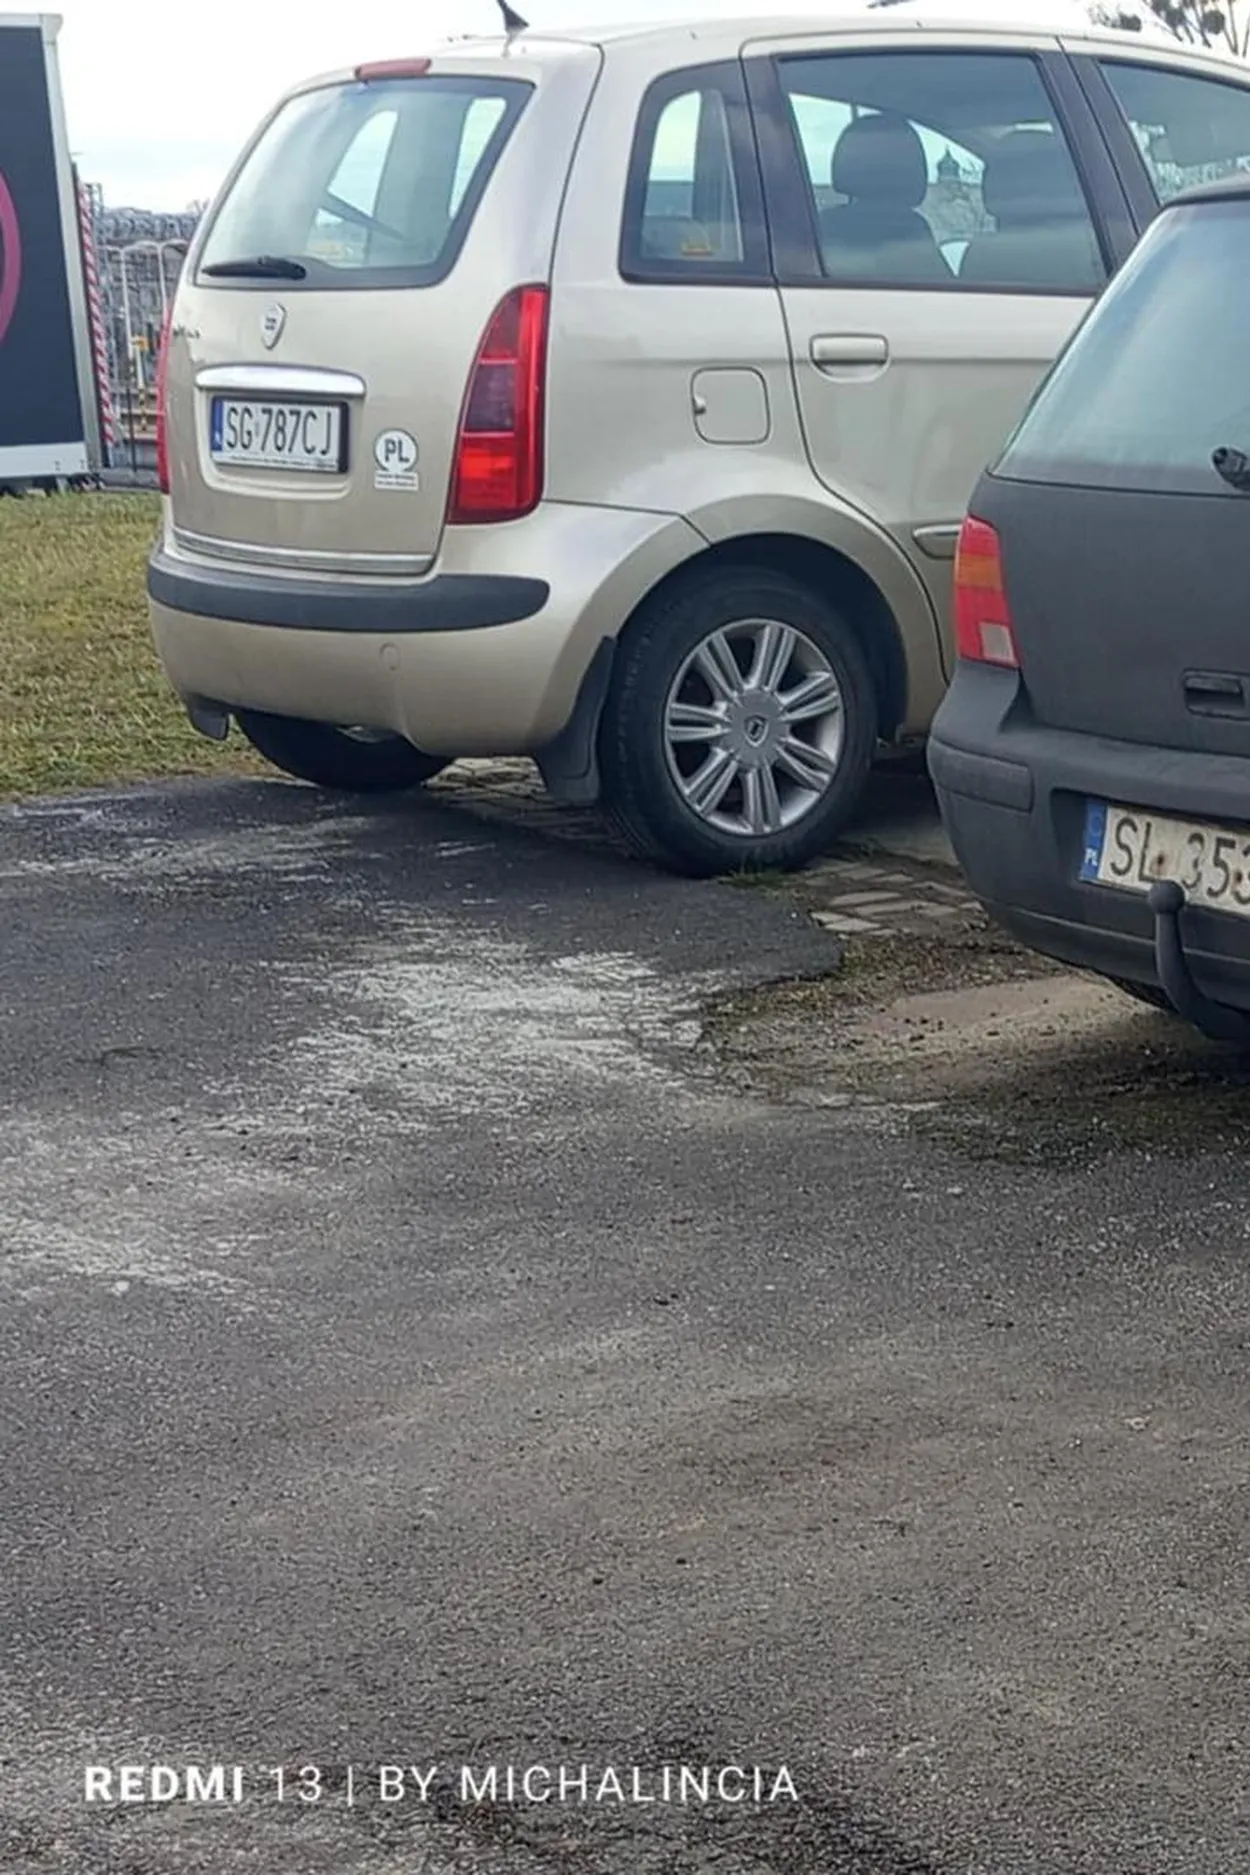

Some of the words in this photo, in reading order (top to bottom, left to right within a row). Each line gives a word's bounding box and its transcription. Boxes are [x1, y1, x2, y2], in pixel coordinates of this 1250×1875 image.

[226, 406, 253, 450] SG
[260, 408, 332, 456] 787CJ
[384, 438, 410, 463] PL
[1109, 817, 1159, 883] SL
